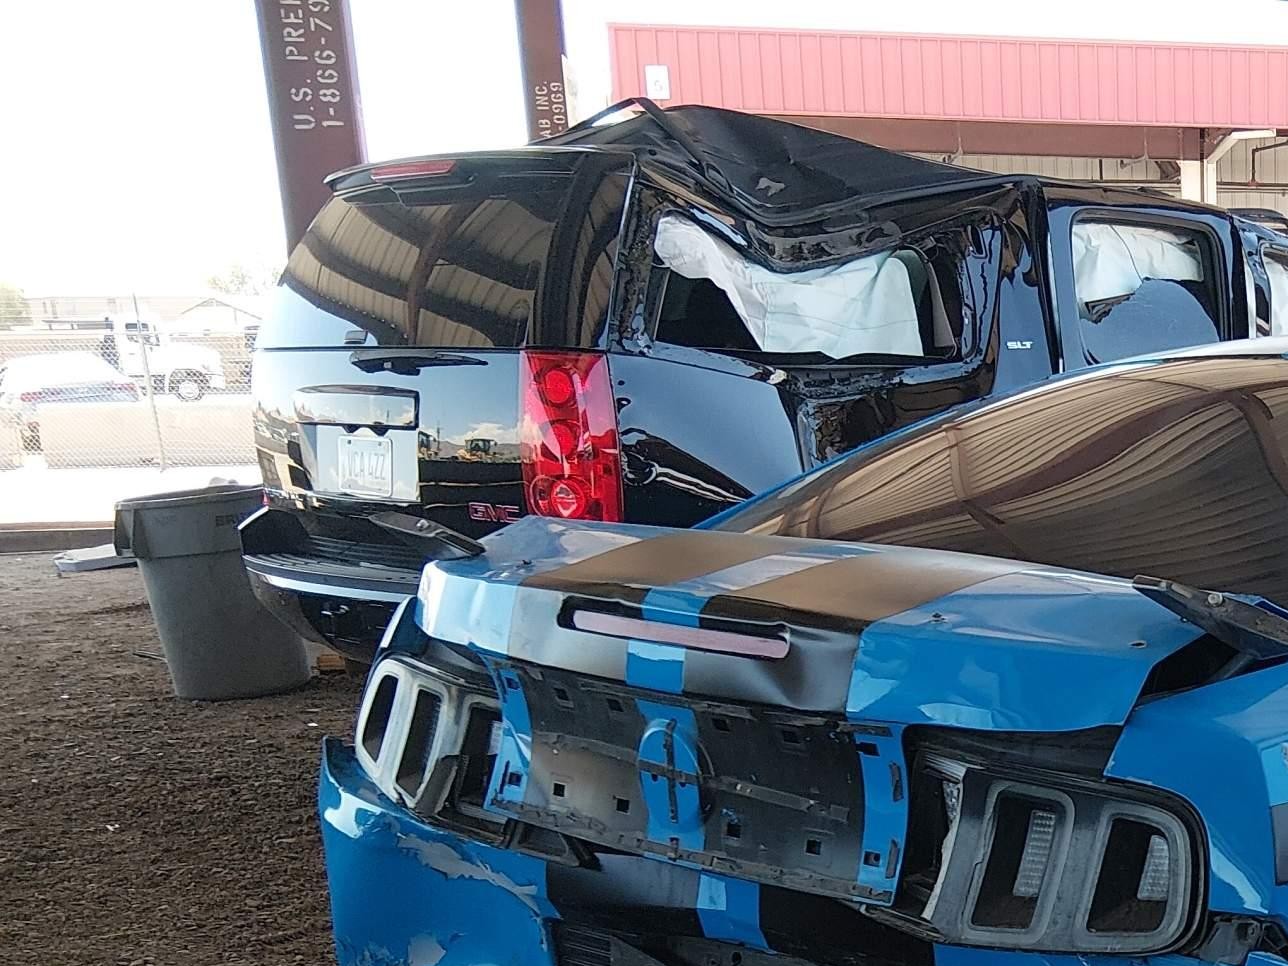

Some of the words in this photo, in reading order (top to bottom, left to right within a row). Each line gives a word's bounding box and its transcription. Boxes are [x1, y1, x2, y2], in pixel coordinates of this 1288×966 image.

[289, 79, 316, 130] U.S.
[534, 81, 550, 110] INC.
[1006, 340, 1033, 349] SLT
[468, 501, 521, 524] GMC
